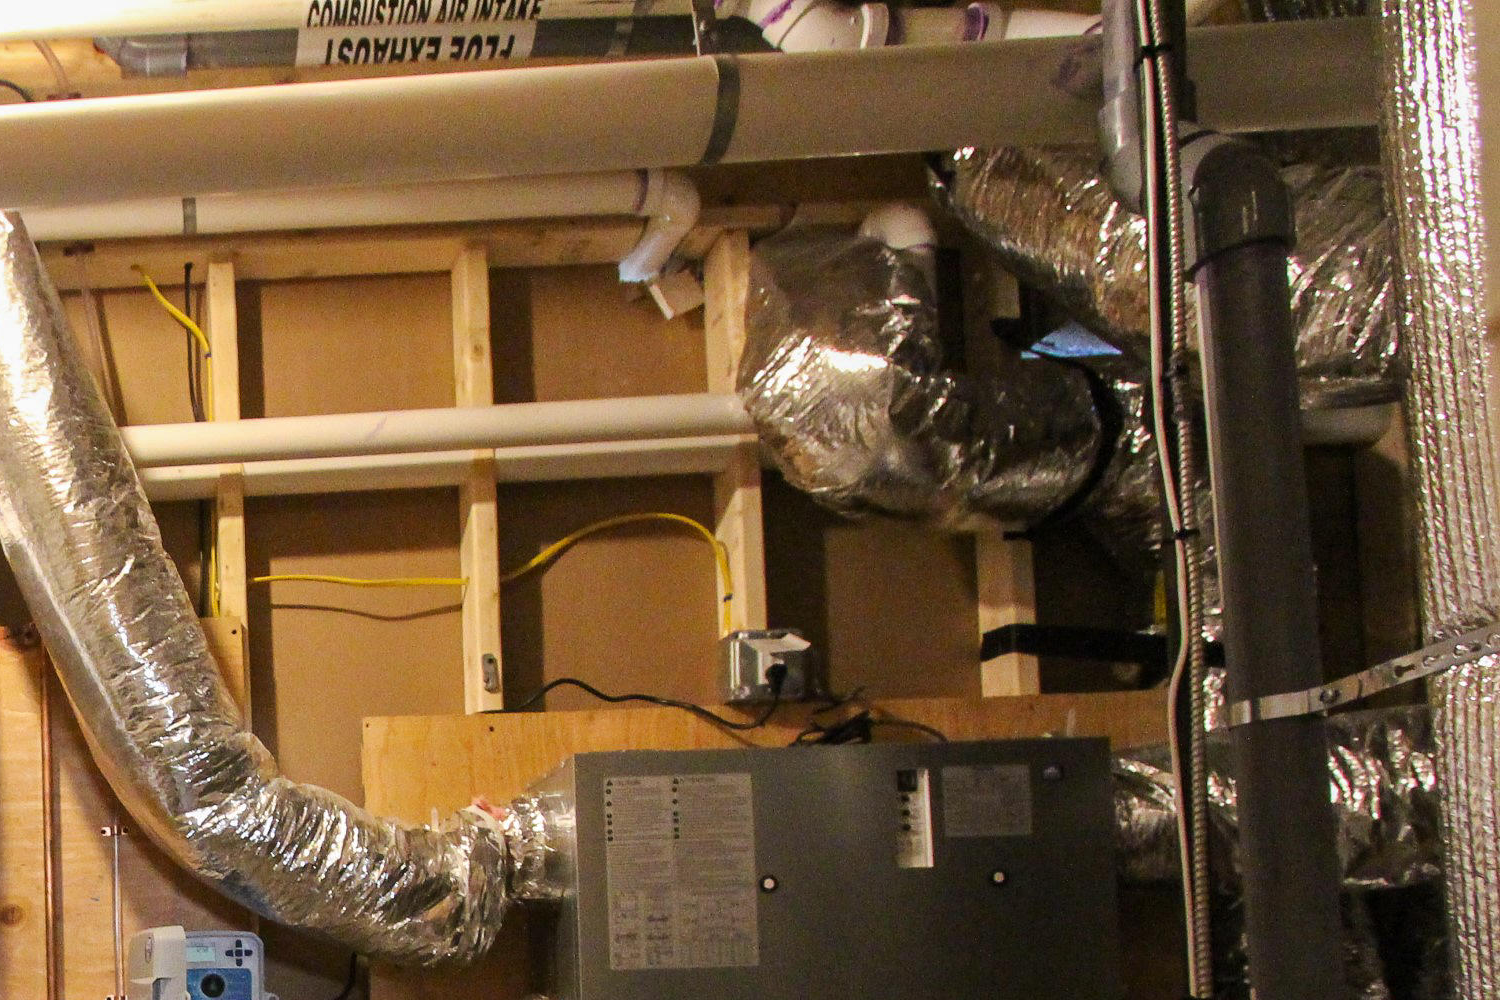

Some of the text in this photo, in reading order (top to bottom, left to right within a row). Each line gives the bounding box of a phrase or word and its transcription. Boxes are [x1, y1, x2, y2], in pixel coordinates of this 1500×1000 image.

[306, 0, 432, 27] COMBUSTION
[435, 0, 468, 23] AIR
[325, 34, 515, 65] FLUE EXHAUST
